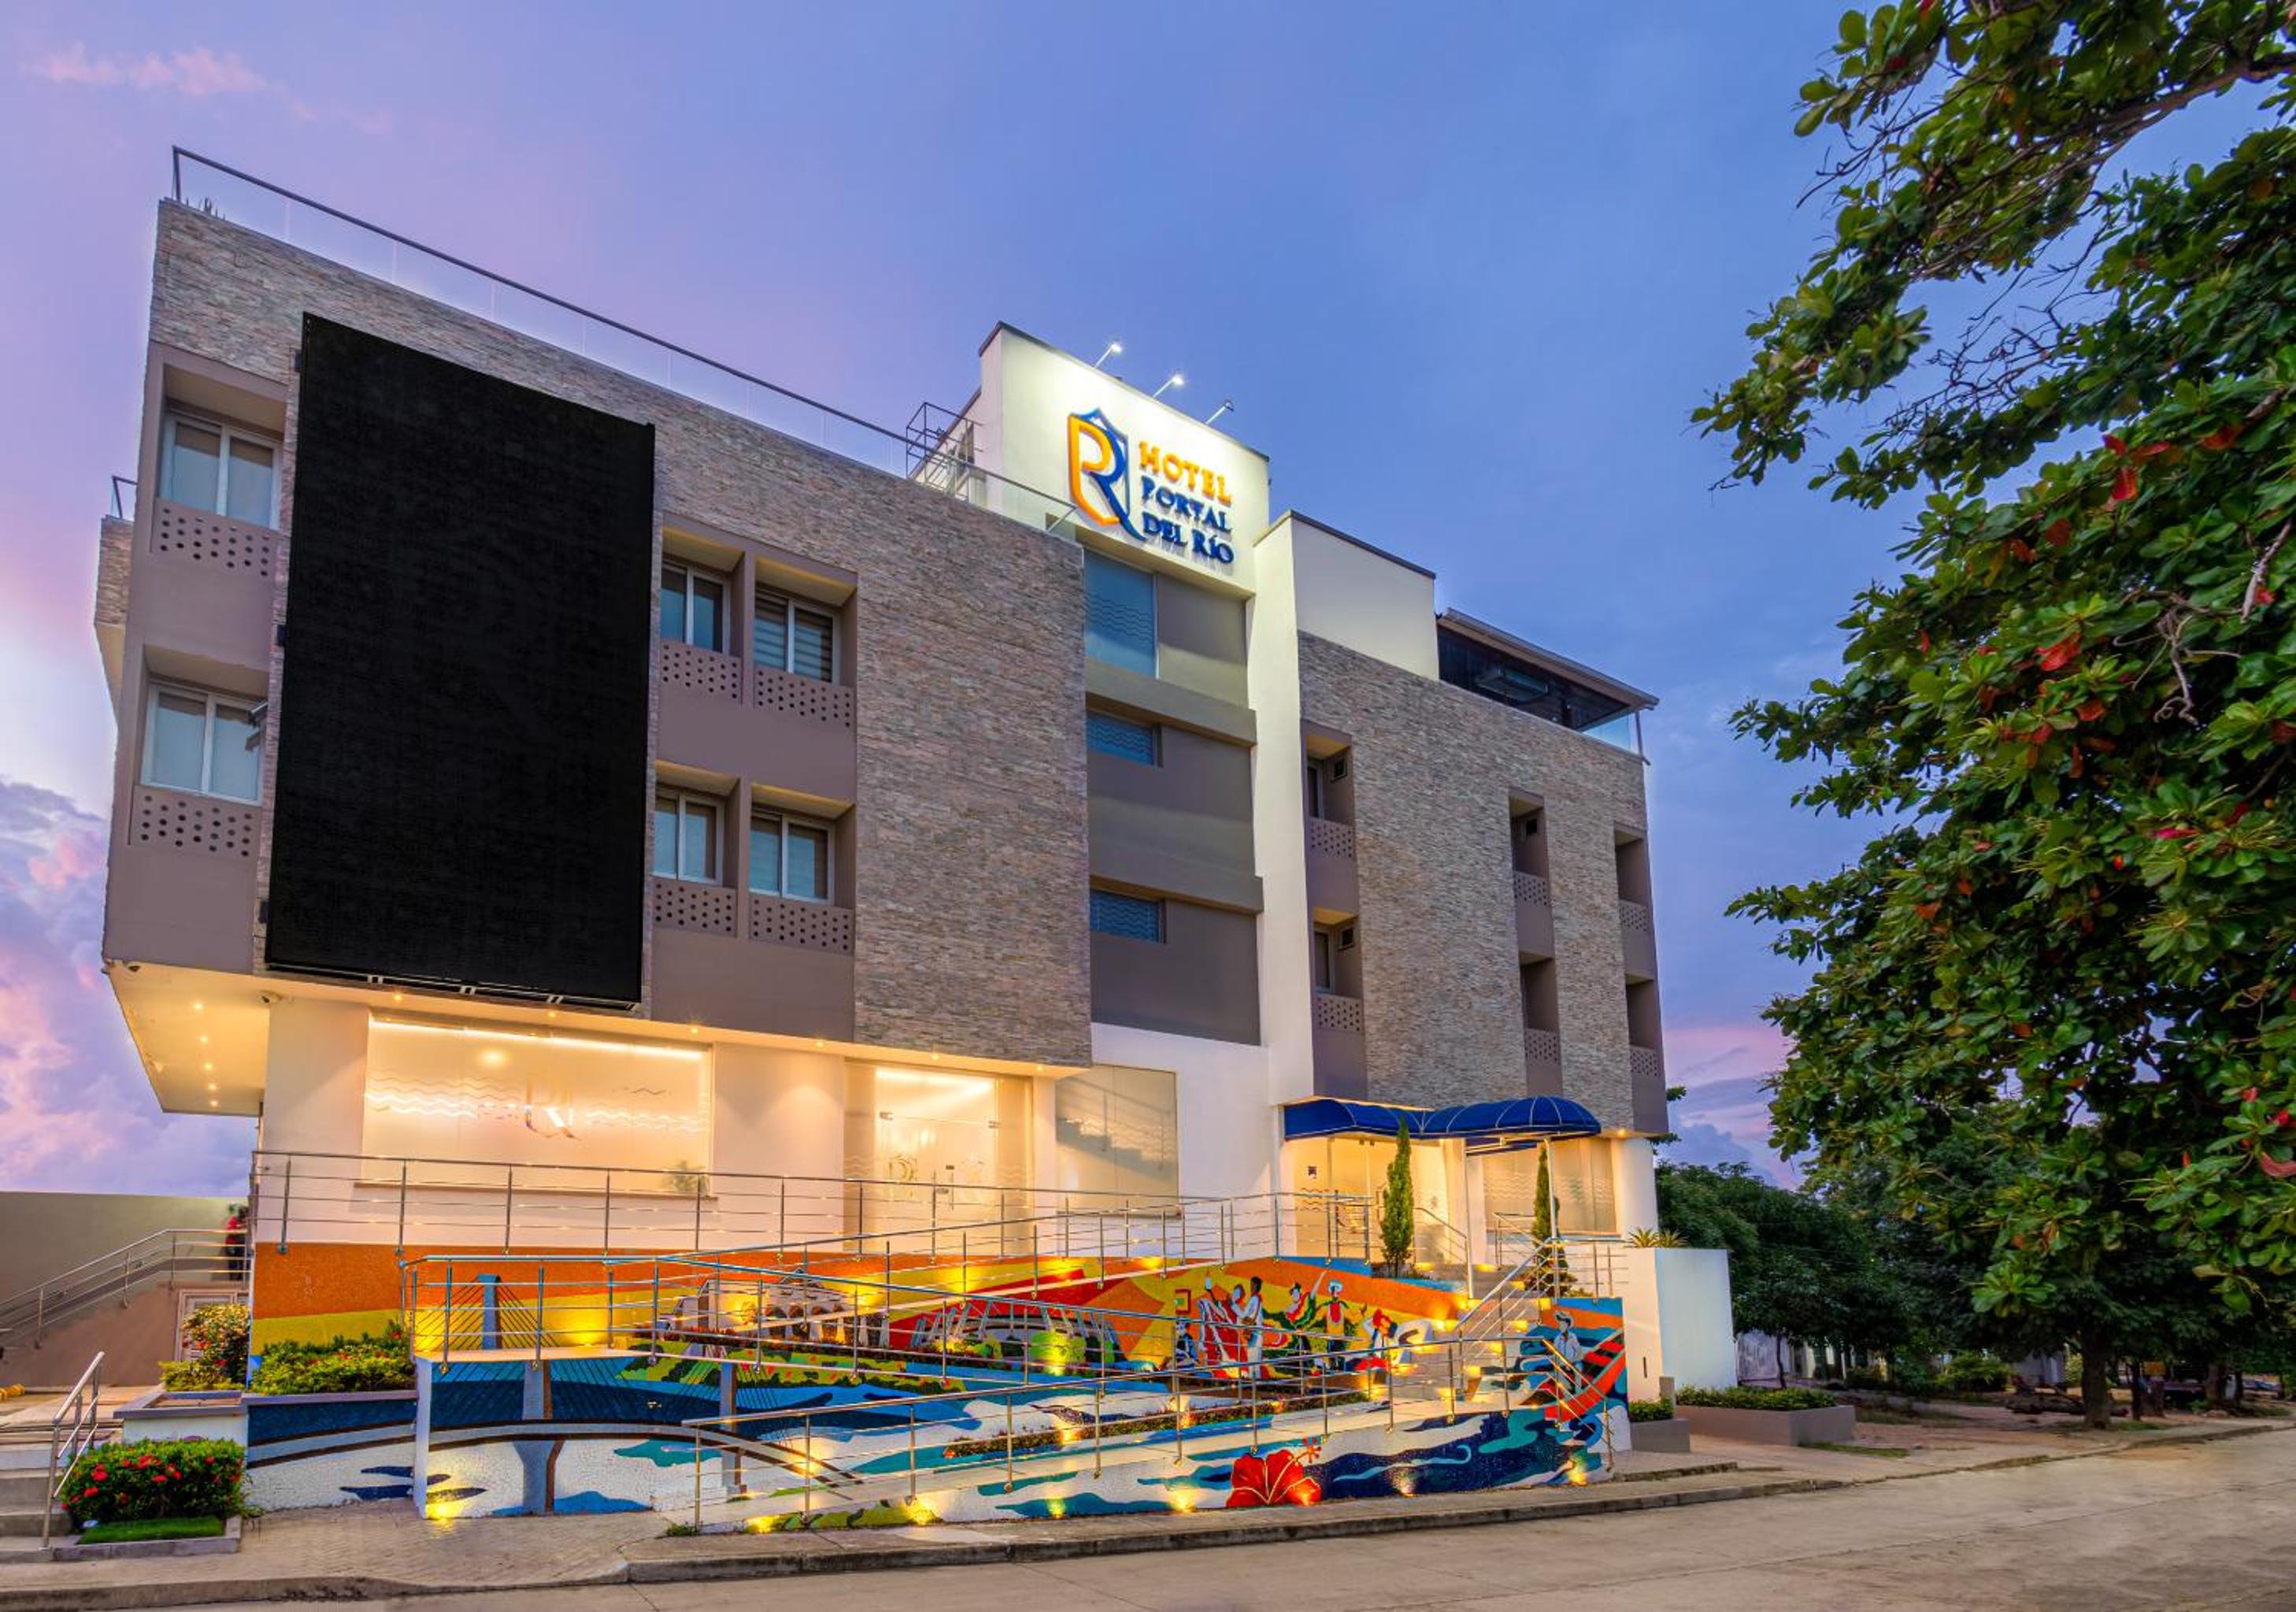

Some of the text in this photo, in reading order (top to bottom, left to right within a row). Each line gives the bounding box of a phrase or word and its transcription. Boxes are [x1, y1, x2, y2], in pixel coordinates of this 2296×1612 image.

[1139, 440, 1232, 506] HOTEL
[1141, 475, 1233, 533] PORTAL
[1141, 512, 1235, 564] DEL RÍO
